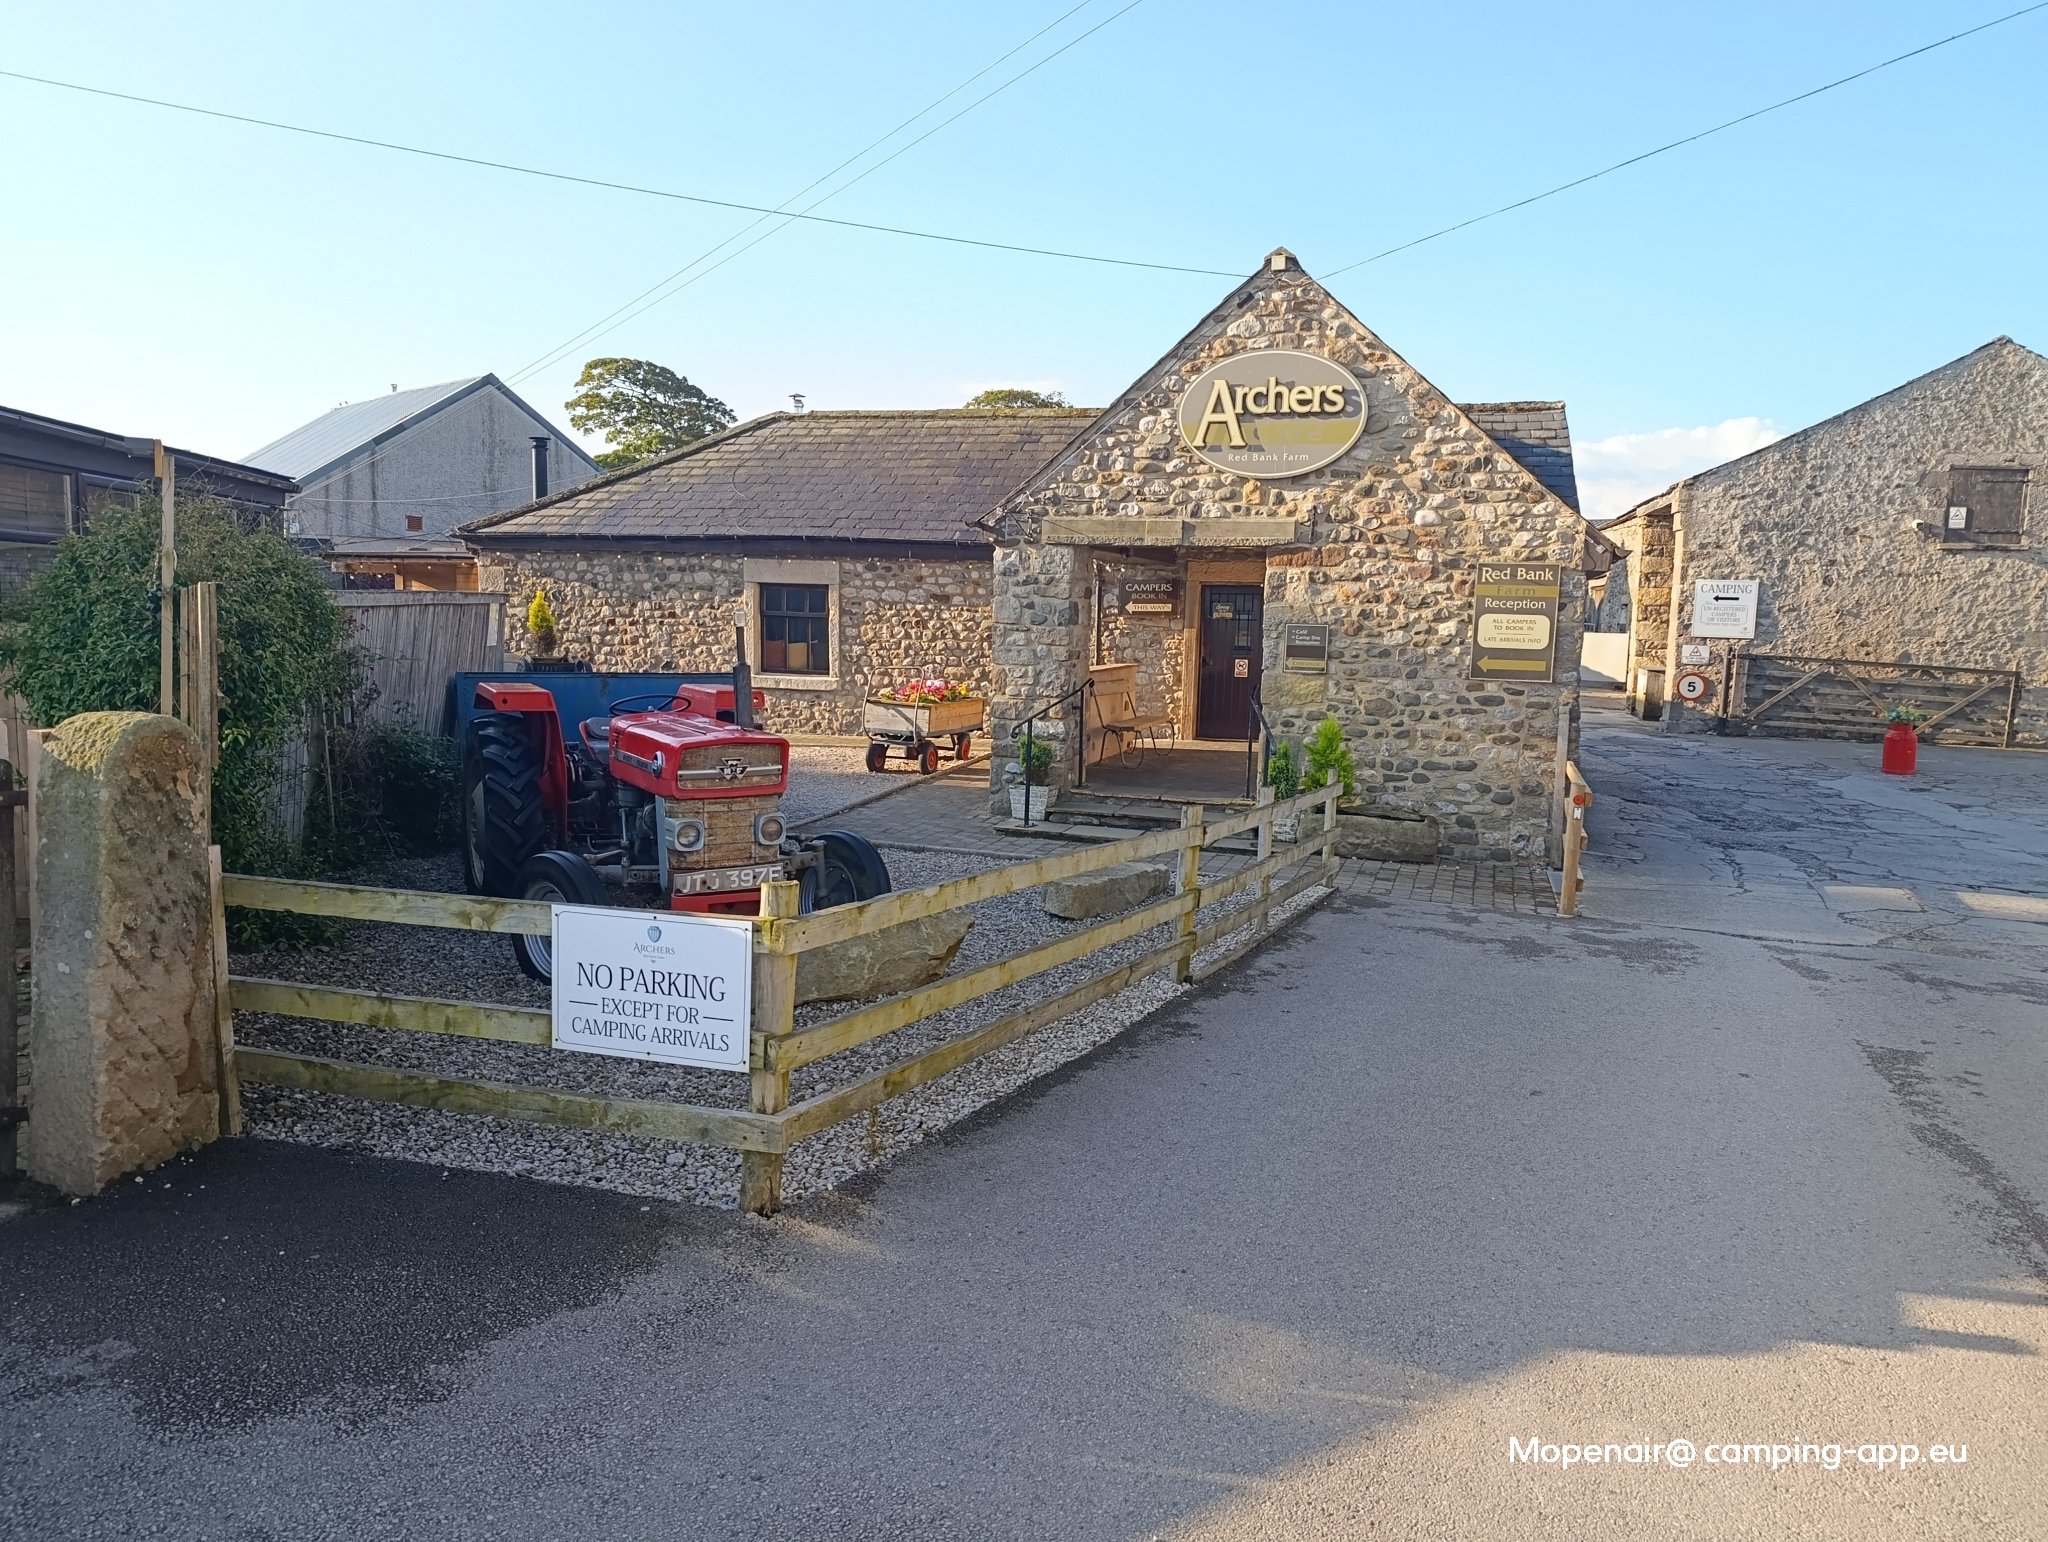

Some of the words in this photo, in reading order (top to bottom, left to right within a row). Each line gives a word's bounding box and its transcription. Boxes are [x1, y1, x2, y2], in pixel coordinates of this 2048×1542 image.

[1191, 376, 1345, 447] Archers
[1228, 453, 1248, 462] Red
[1252, 453, 1279, 462] Bank
[1283, 453, 1309, 461] Farm
[1481, 567, 1511, 582] Red
[1517, 568, 1554, 580] Bank
[1125, 583, 1173, 591] CAMPERS
[1496, 585, 1536, 595] Farm
[1700, 583, 1753, 594] CAMPING
[1484, 597, 1546, 611] Reception
[1687, 682, 1696, 692] 5
[633, 942, 676, 955] ARCHERS
[576, 961, 613, 989] NO
[619, 966, 727, 1002] PARKING
[601, 997, 664, 1021] EXCEPT
[667, 1004, 700, 1025] FOR
[571, 1016, 647, 1041] CAMPING
[650, 1026, 730, 1052] ARRIVALS
